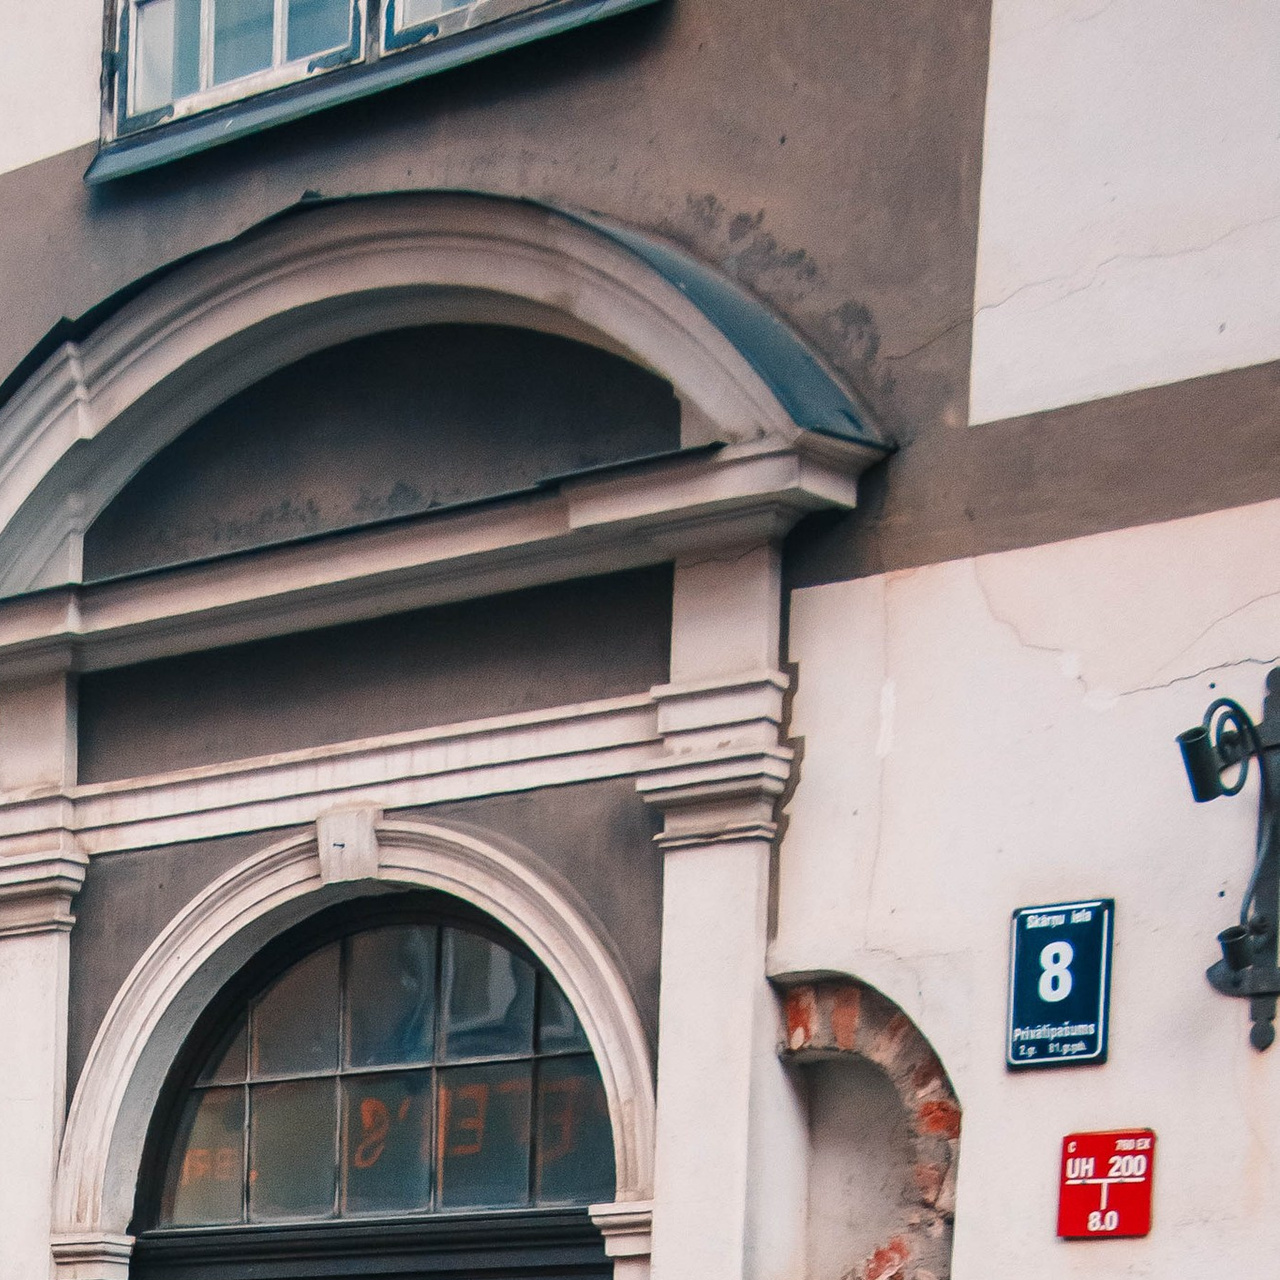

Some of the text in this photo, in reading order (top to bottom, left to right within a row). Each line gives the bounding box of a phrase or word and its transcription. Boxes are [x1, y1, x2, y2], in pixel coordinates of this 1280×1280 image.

[1038, 940, 1074, 1003] 8
[1065, 1154, 1148, 1179] UH 200
[1087, 1210, 1119, 1231] 8.0
